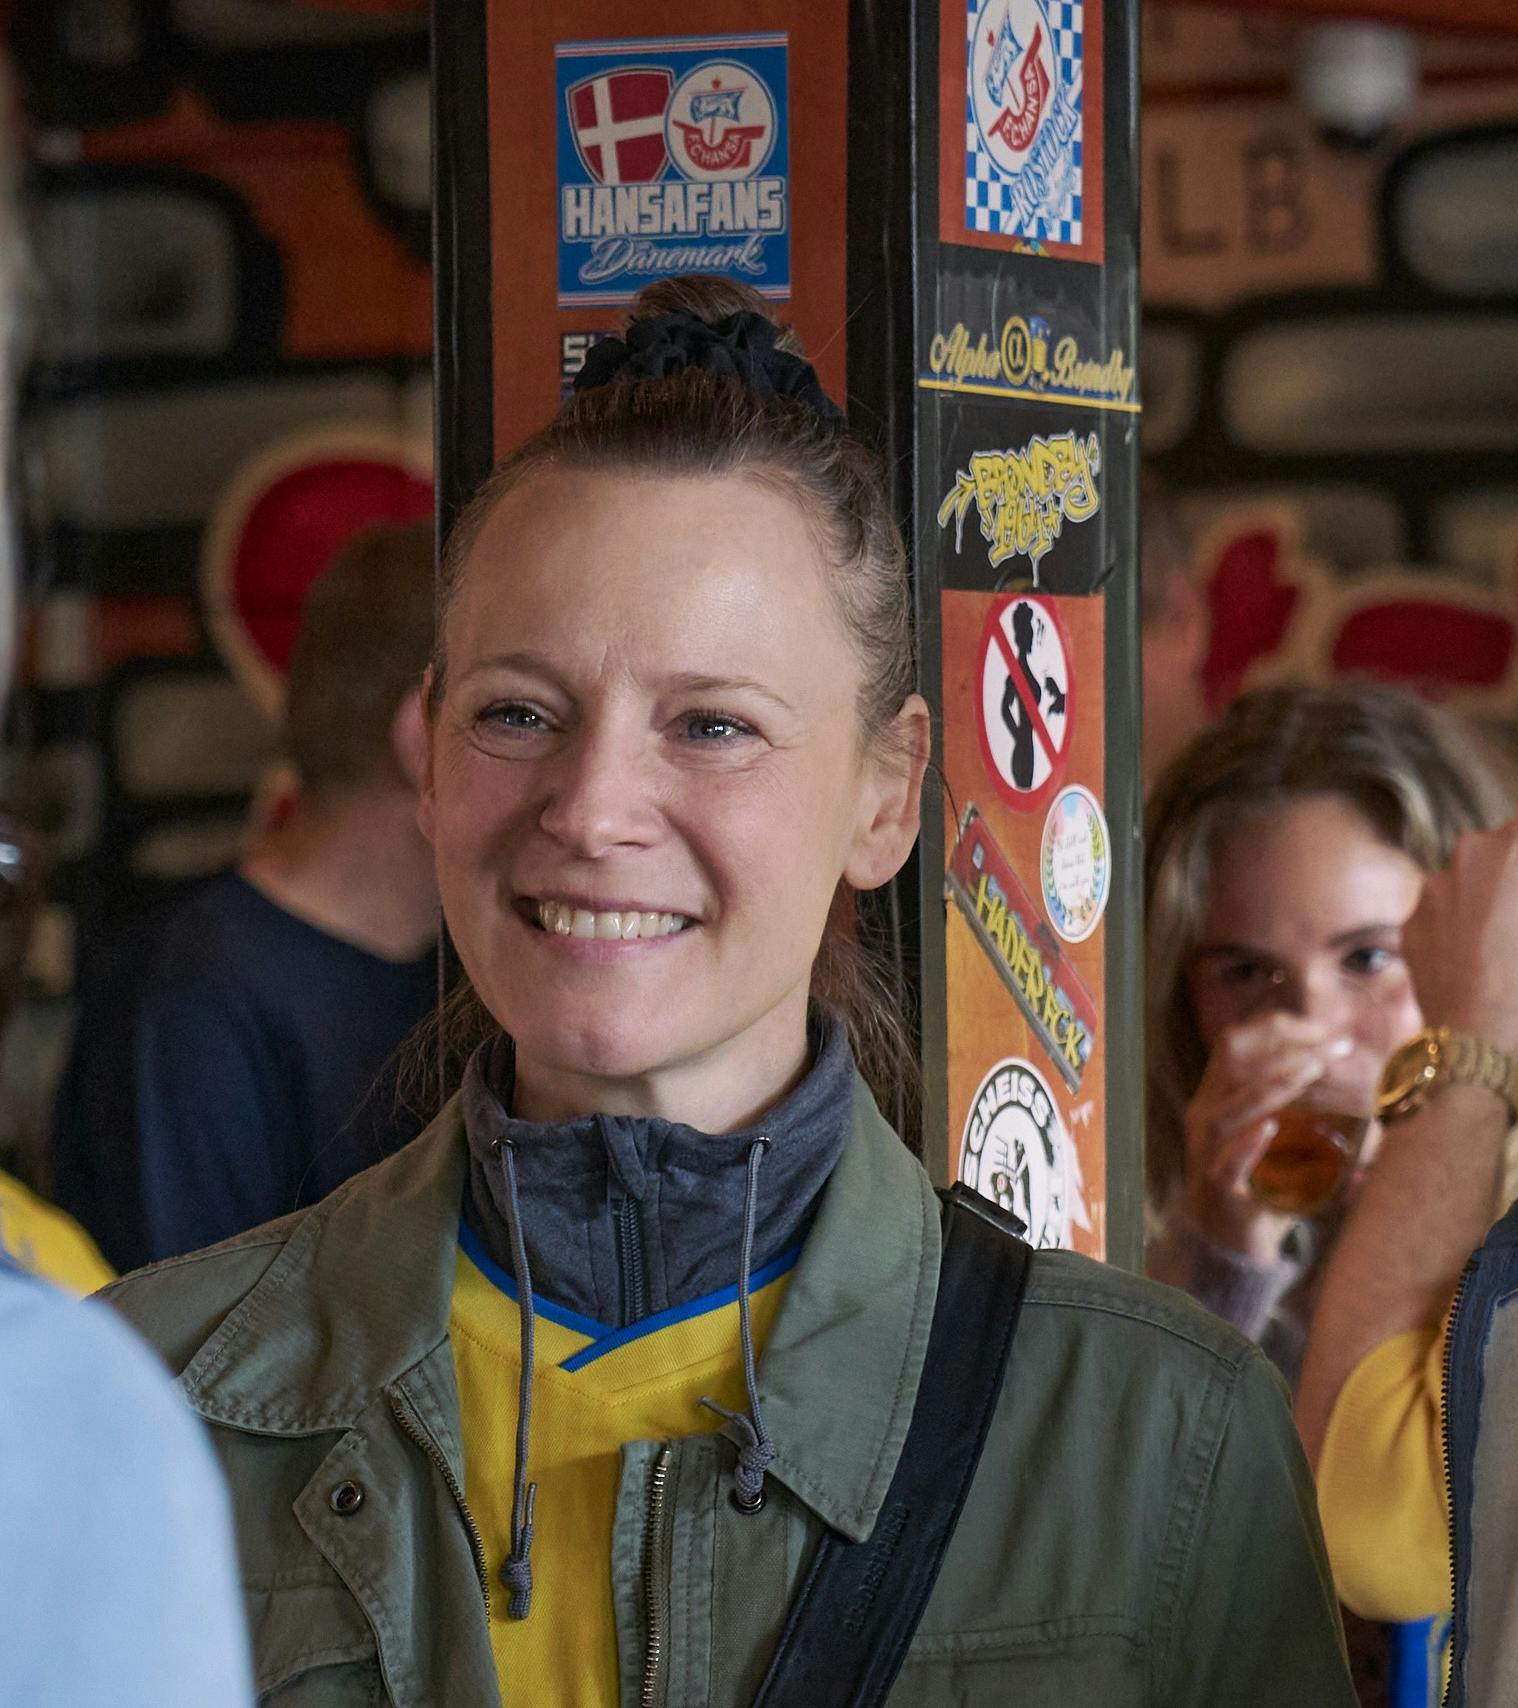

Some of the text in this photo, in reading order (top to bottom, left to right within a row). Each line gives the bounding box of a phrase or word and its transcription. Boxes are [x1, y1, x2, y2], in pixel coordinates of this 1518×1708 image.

[564, 179, 784, 238] HANSAFANS
[580, 236, 766, 283] Dänemark
[930, 322, 1001, 384] Alpha
